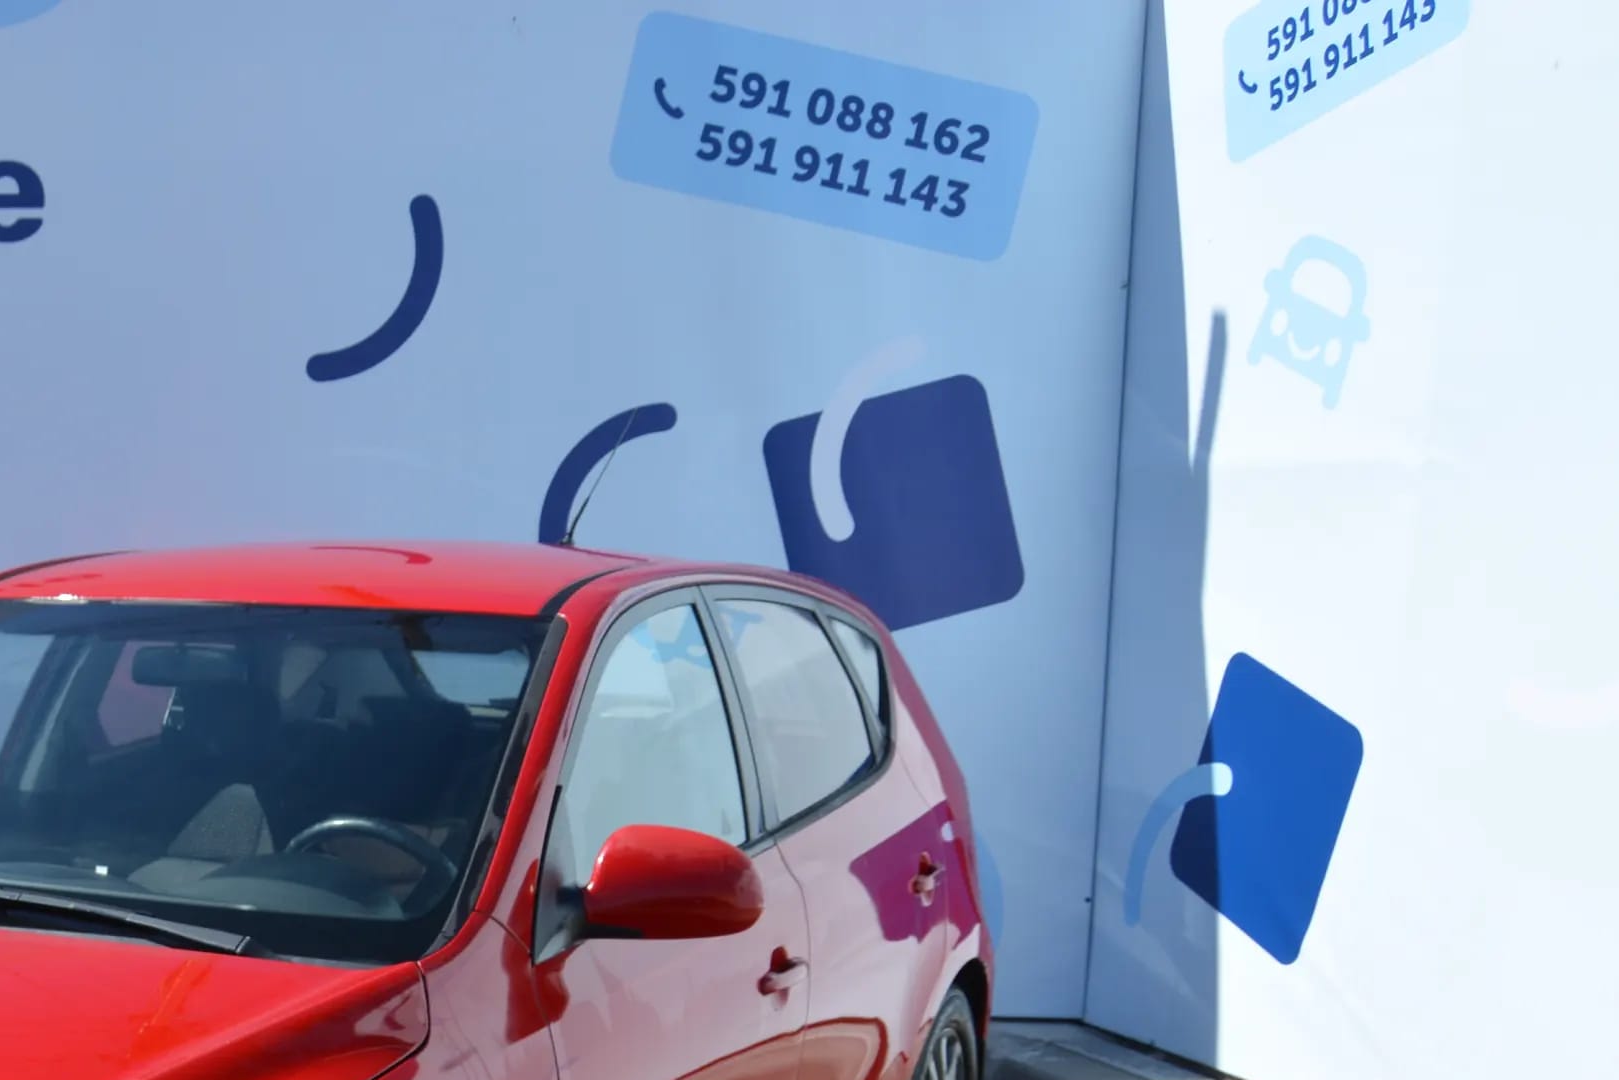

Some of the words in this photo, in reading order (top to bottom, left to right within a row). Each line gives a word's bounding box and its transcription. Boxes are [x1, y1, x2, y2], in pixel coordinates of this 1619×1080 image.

[1268, 7, 1315, 61] 591
[1269, 57, 1317, 111] 591
[1323, 23, 1375, 80] 911
[1382, 0, 1436, 46] 143
[709, 64, 791, 119] 591
[806, 87, 895, 140] 088
[904, 111, 990, 163] 162
[695, 122, 778, 176] 591
[792, 144, 870, 197] 911
[883, 167, 970, 218] 143
